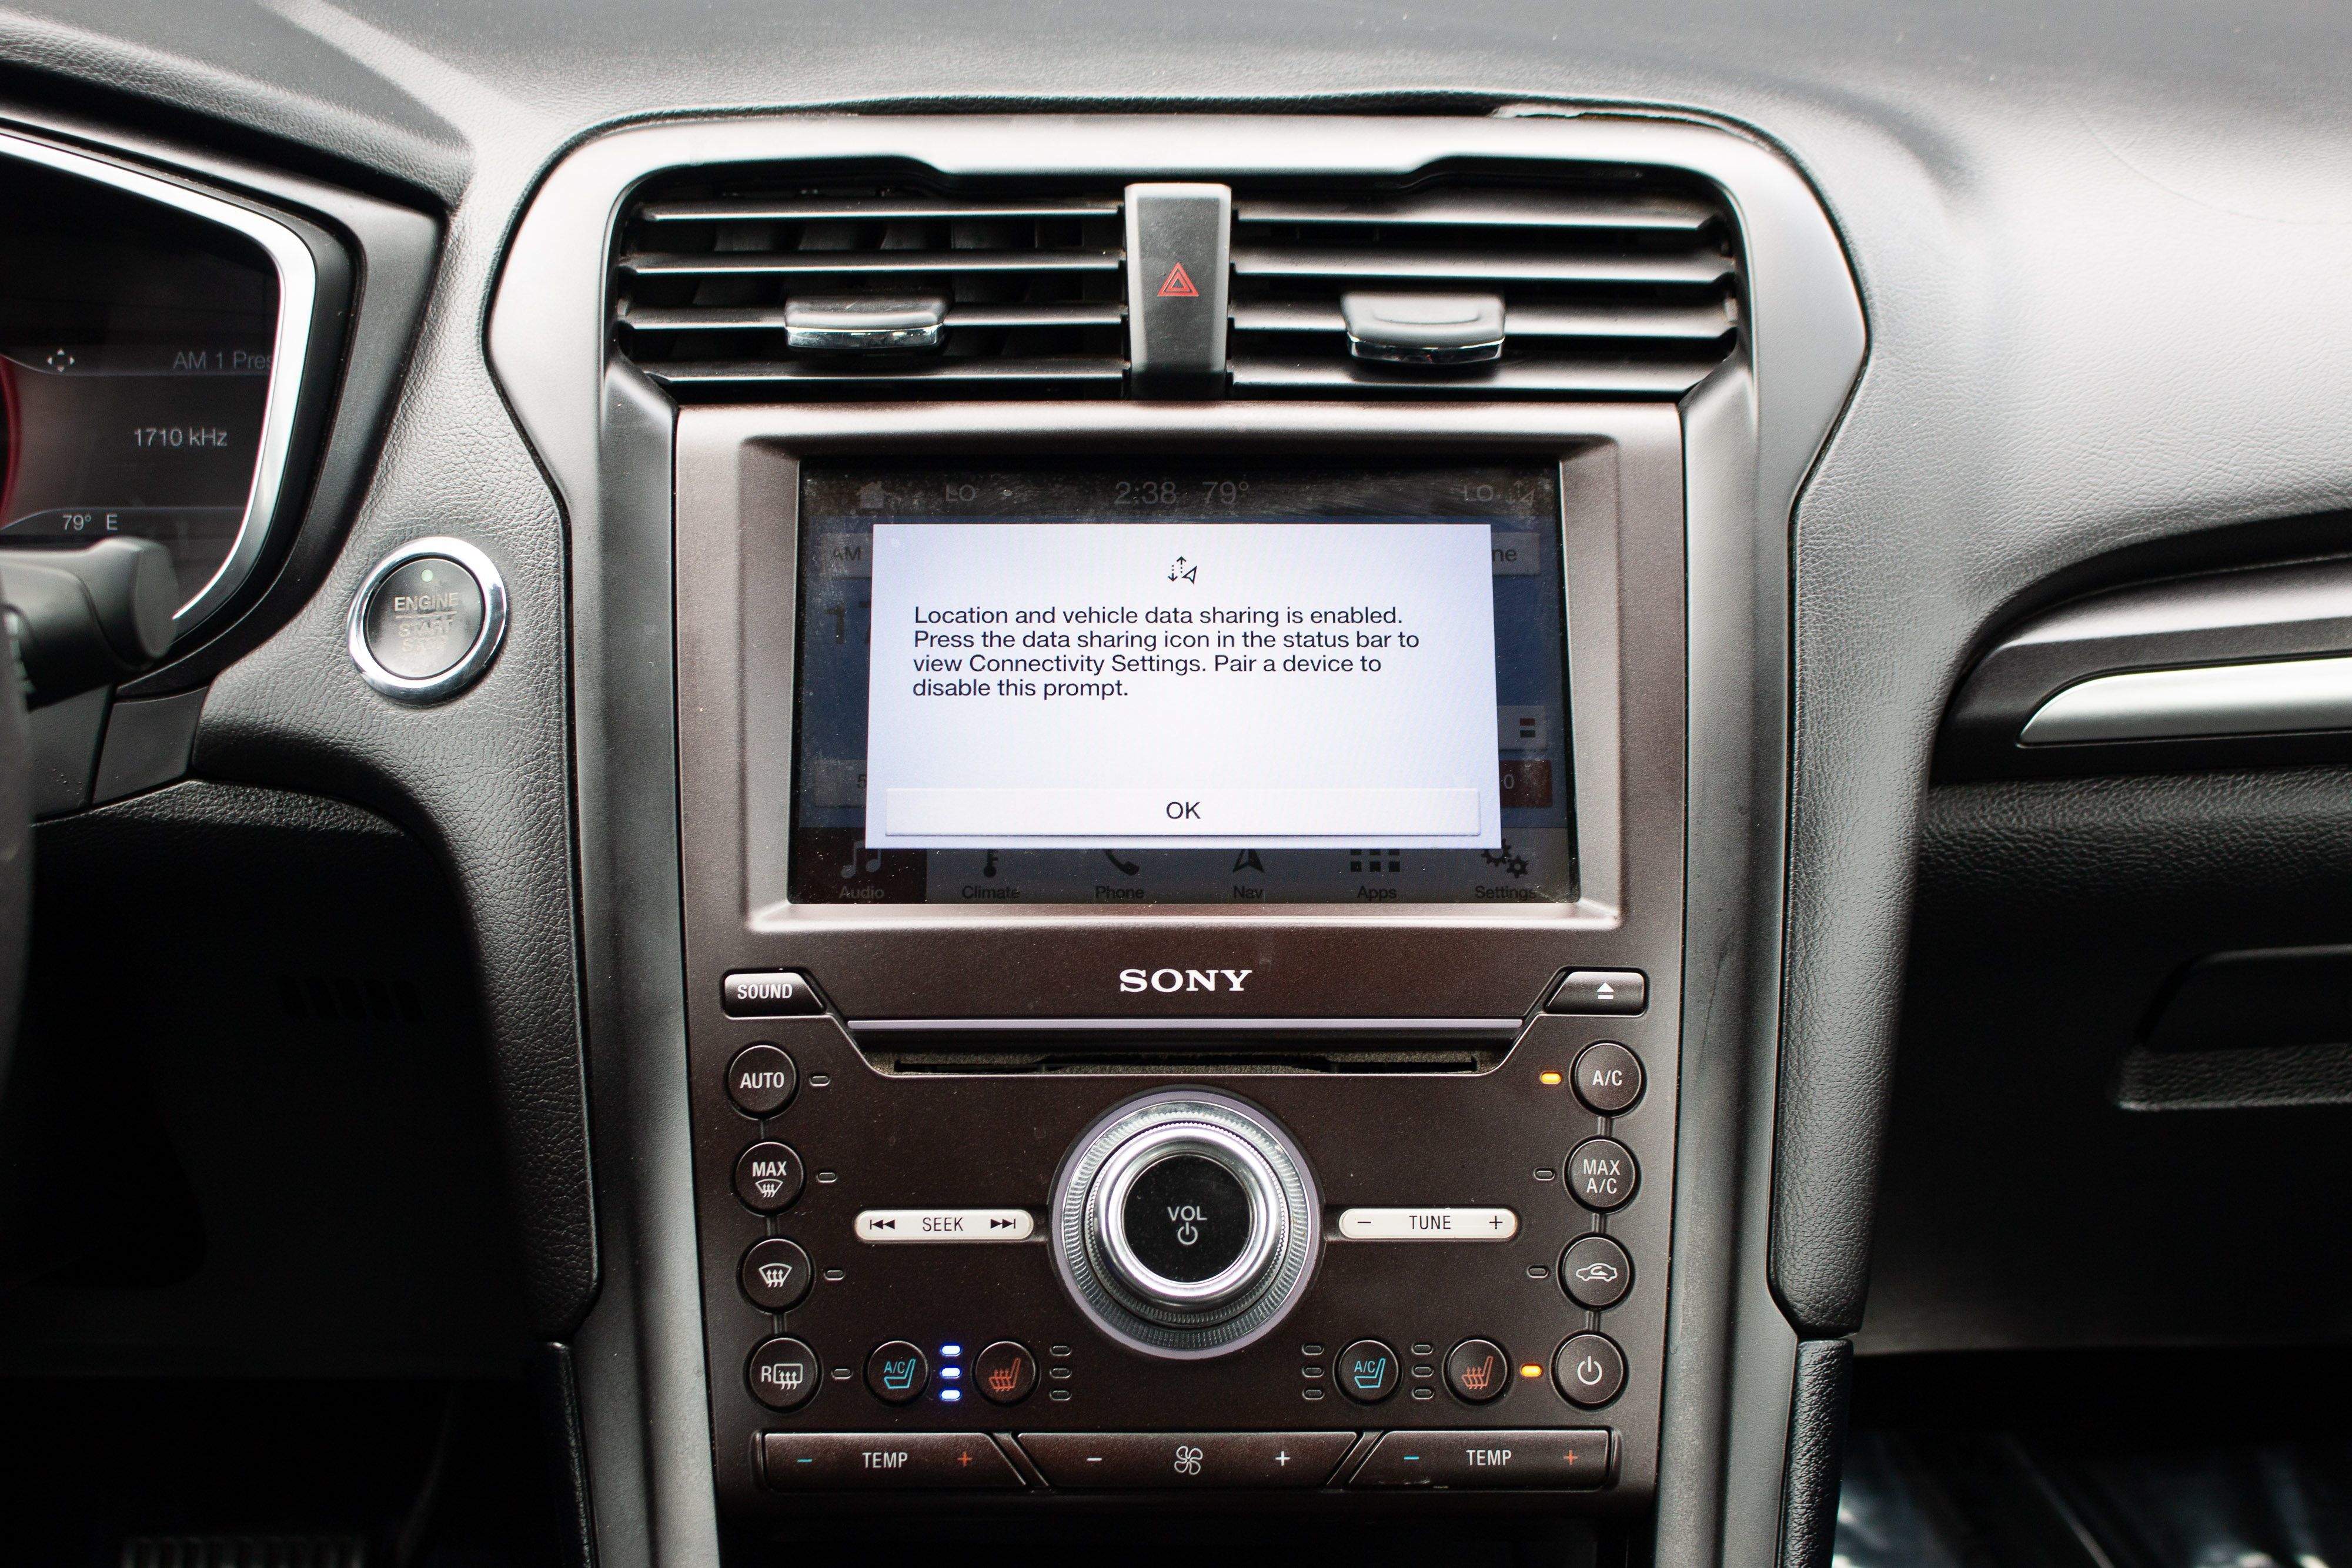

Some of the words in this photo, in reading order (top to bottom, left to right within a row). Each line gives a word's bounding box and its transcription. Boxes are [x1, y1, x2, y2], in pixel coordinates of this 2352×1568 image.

[173, 352, 206, 369] AM
[216, 352, 222, 369] 1
[134, 428, 182, 447] 1710
[189, 427, 228, 447] kHz
[946, 484, 977, 502] LO
[1114, 481, 1176, 504] 2:38
[106, 514, 118, 531] E
[833, 546, 861, 561] AM
[394, 592, 459, 612] ENGINE
[915, 606, 1008, 624] Location
[1015, 606, 1055, 624] and
[1063, 606, 1138, 624] vehicle
[1145, 606, 1193, 624] data
[1200, 606, 1279, 628] sharing
[1287, 606, 1304, 624] is
[1310, 606, 1402, 624] enabled.
[914, 630, 974, 648] Press
[981, 630, 1015, 648] the
[1023, 630, 1071, 648] data
[1077, 630, 1157, 652] sharing
[1165, 630, 1210, 648] icon
[1218, 630, 1235, 647] in
[1241, 630, 1276, 648] the
[1283, 631, 1349, 648] status
[1357, 630, 1392, 648] bar
[1397, 631, 1419, 648] to
[913, 654, 963, 672] view
[969, 654, 1105, 676] Connectivity
[1111, 654, 1206, 676] Settings.
[1215, 654, 1257, 672] Pair
[1263, 658, 1277, 672] a
[1283, 654, 1354, 672] device
[1359, 656, 1381, 672] to
[913, 678, 991, 696] disable
[997, 678, 1036, 696] this
[1044, 680, 1128, 700] prompt.
[1166, 801, 1201, 820] OK
[839, 885, 885, 900] Audio
[961, 885, 1020, 900] Climate
[1095, 885, 1145, 900] Phone
[1234, 885, 1263, 900] Nav
[1357, 885, 1397, 901] Apps
[1475, 885, 1536, 901] Settings
[1119, 968, 1252, 992] SONY
[737, 983, 793, 999] SOUND
[740, 1072, 785, 1089] AUTO
[1592, 1070, 1623, 1086] A/C
[752, 1161, 787, 1177] MAX
[1582, 1159, 1621, 1176] MAX
[1586, 1178, 1618, 1195] A/C
[1167, 1205, 1207, 1221] VOL
[922, 1217, 964, 1232] SEEK
[1409, 1215, 1451, 1230] TUNE
[761, 1366, 772, 1383] R
[883, 1360, 906, 1375] A/C
[1354, 1360, 1376, 1373] A/C
[862, 1452, 908, 1468] TEMP
[1466, 1449, 1512, 1466] TEMP
